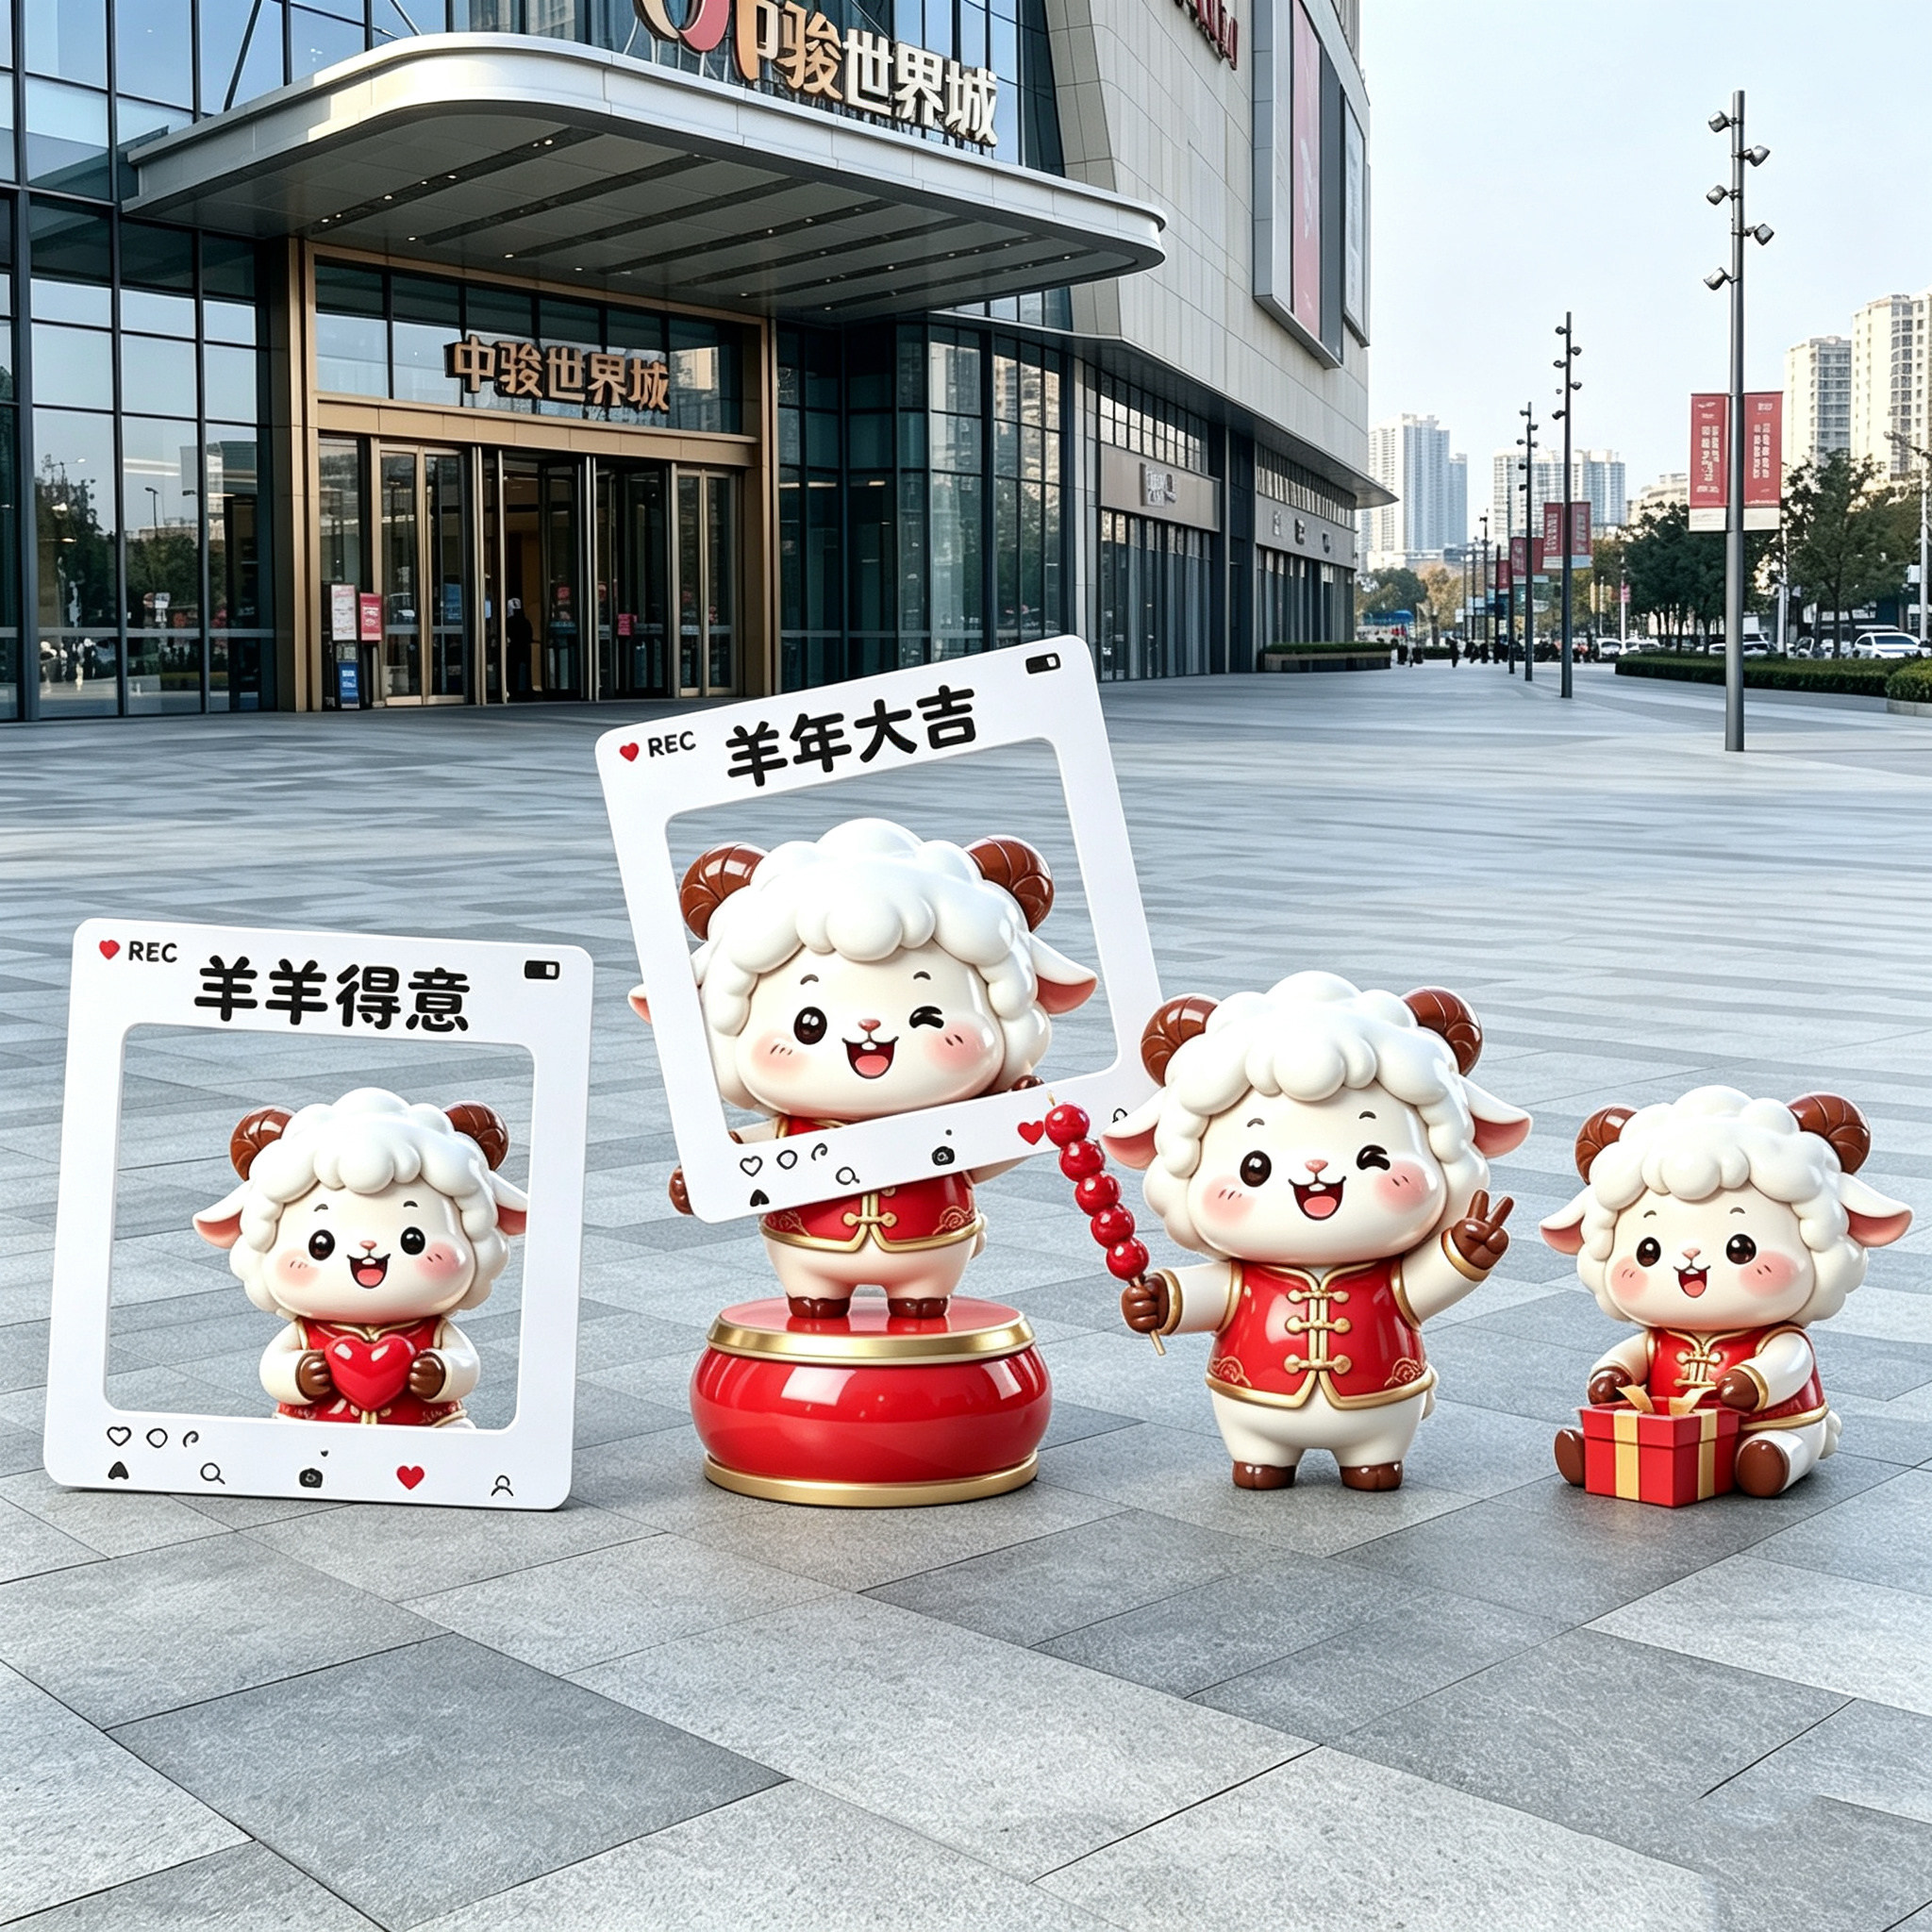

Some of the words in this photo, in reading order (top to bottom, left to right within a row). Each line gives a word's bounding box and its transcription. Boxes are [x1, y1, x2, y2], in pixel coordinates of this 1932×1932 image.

[451, 335, 670, 411] 中骏世界城
[647, 730, 696, 758] REC
[725, 684, 976, 787] 羊年大吉
[127, 941, 178, 963] REC
[193, 955, 472, 1033] 羊羊得意
